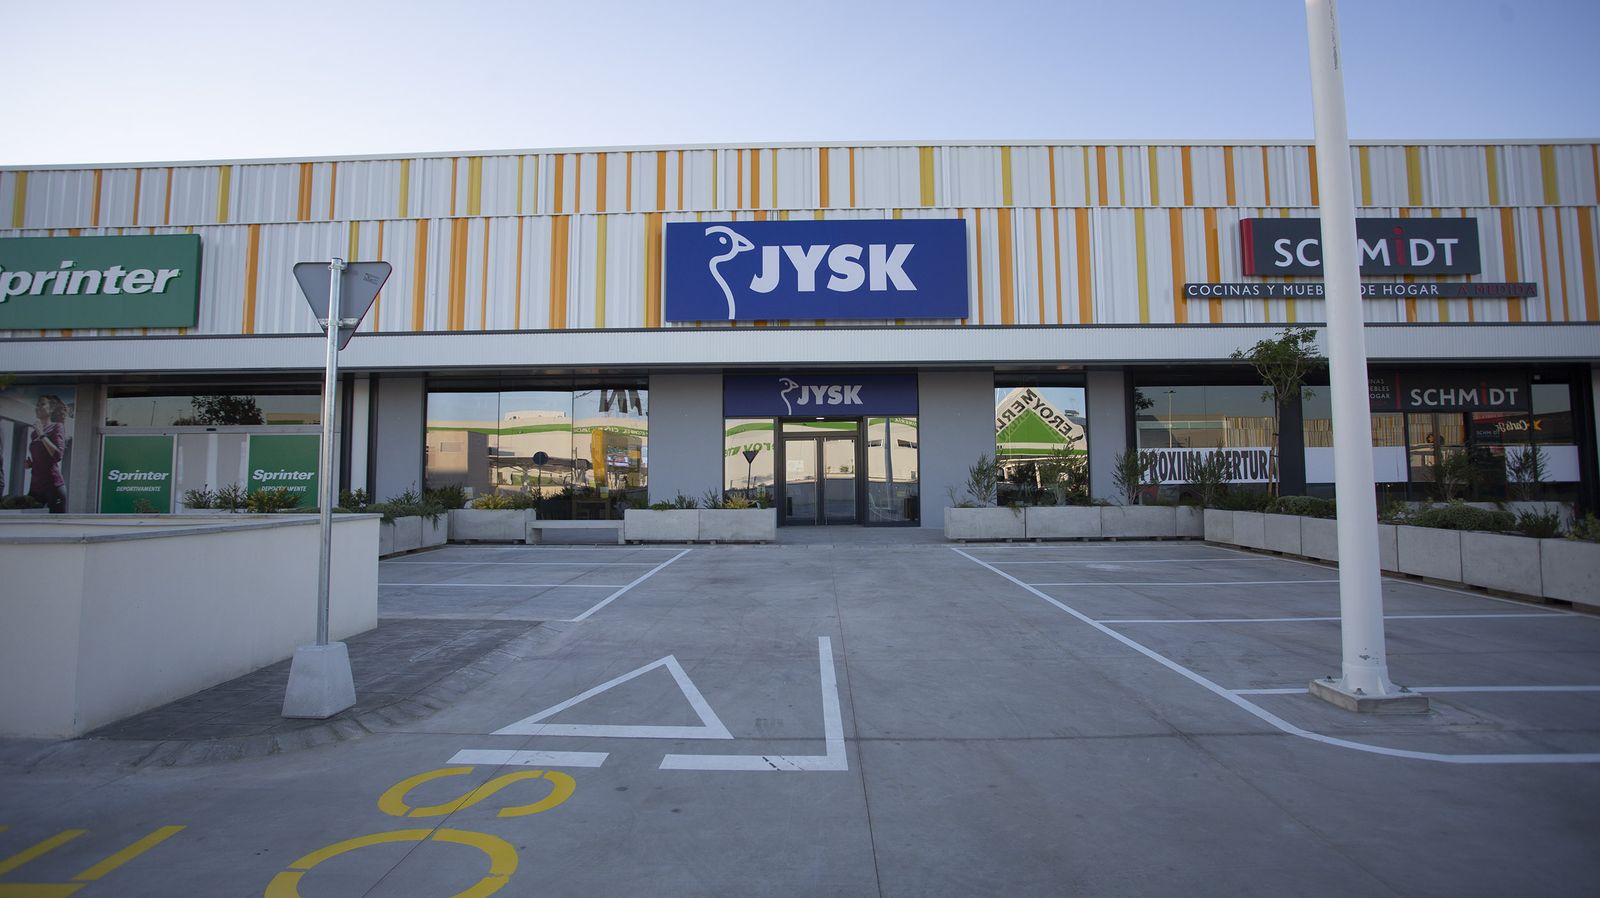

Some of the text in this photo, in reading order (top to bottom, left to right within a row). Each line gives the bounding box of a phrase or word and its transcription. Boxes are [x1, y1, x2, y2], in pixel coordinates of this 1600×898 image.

[749, 243, 918, 294] JYSK
[0, 260, 181, 302] printer
[1188, 284, 1260, 297] COCINAS
[1267, 284, 1276, 297] Y
[1283, 284, 1325, 296] MUEB
[1383, 284, 1439, 296] HOGAR
[797, 385, 864, 405] JYSK
[108, 469, 169, 482] Sprinter
[252, 469, 315, 482] Sprinter
